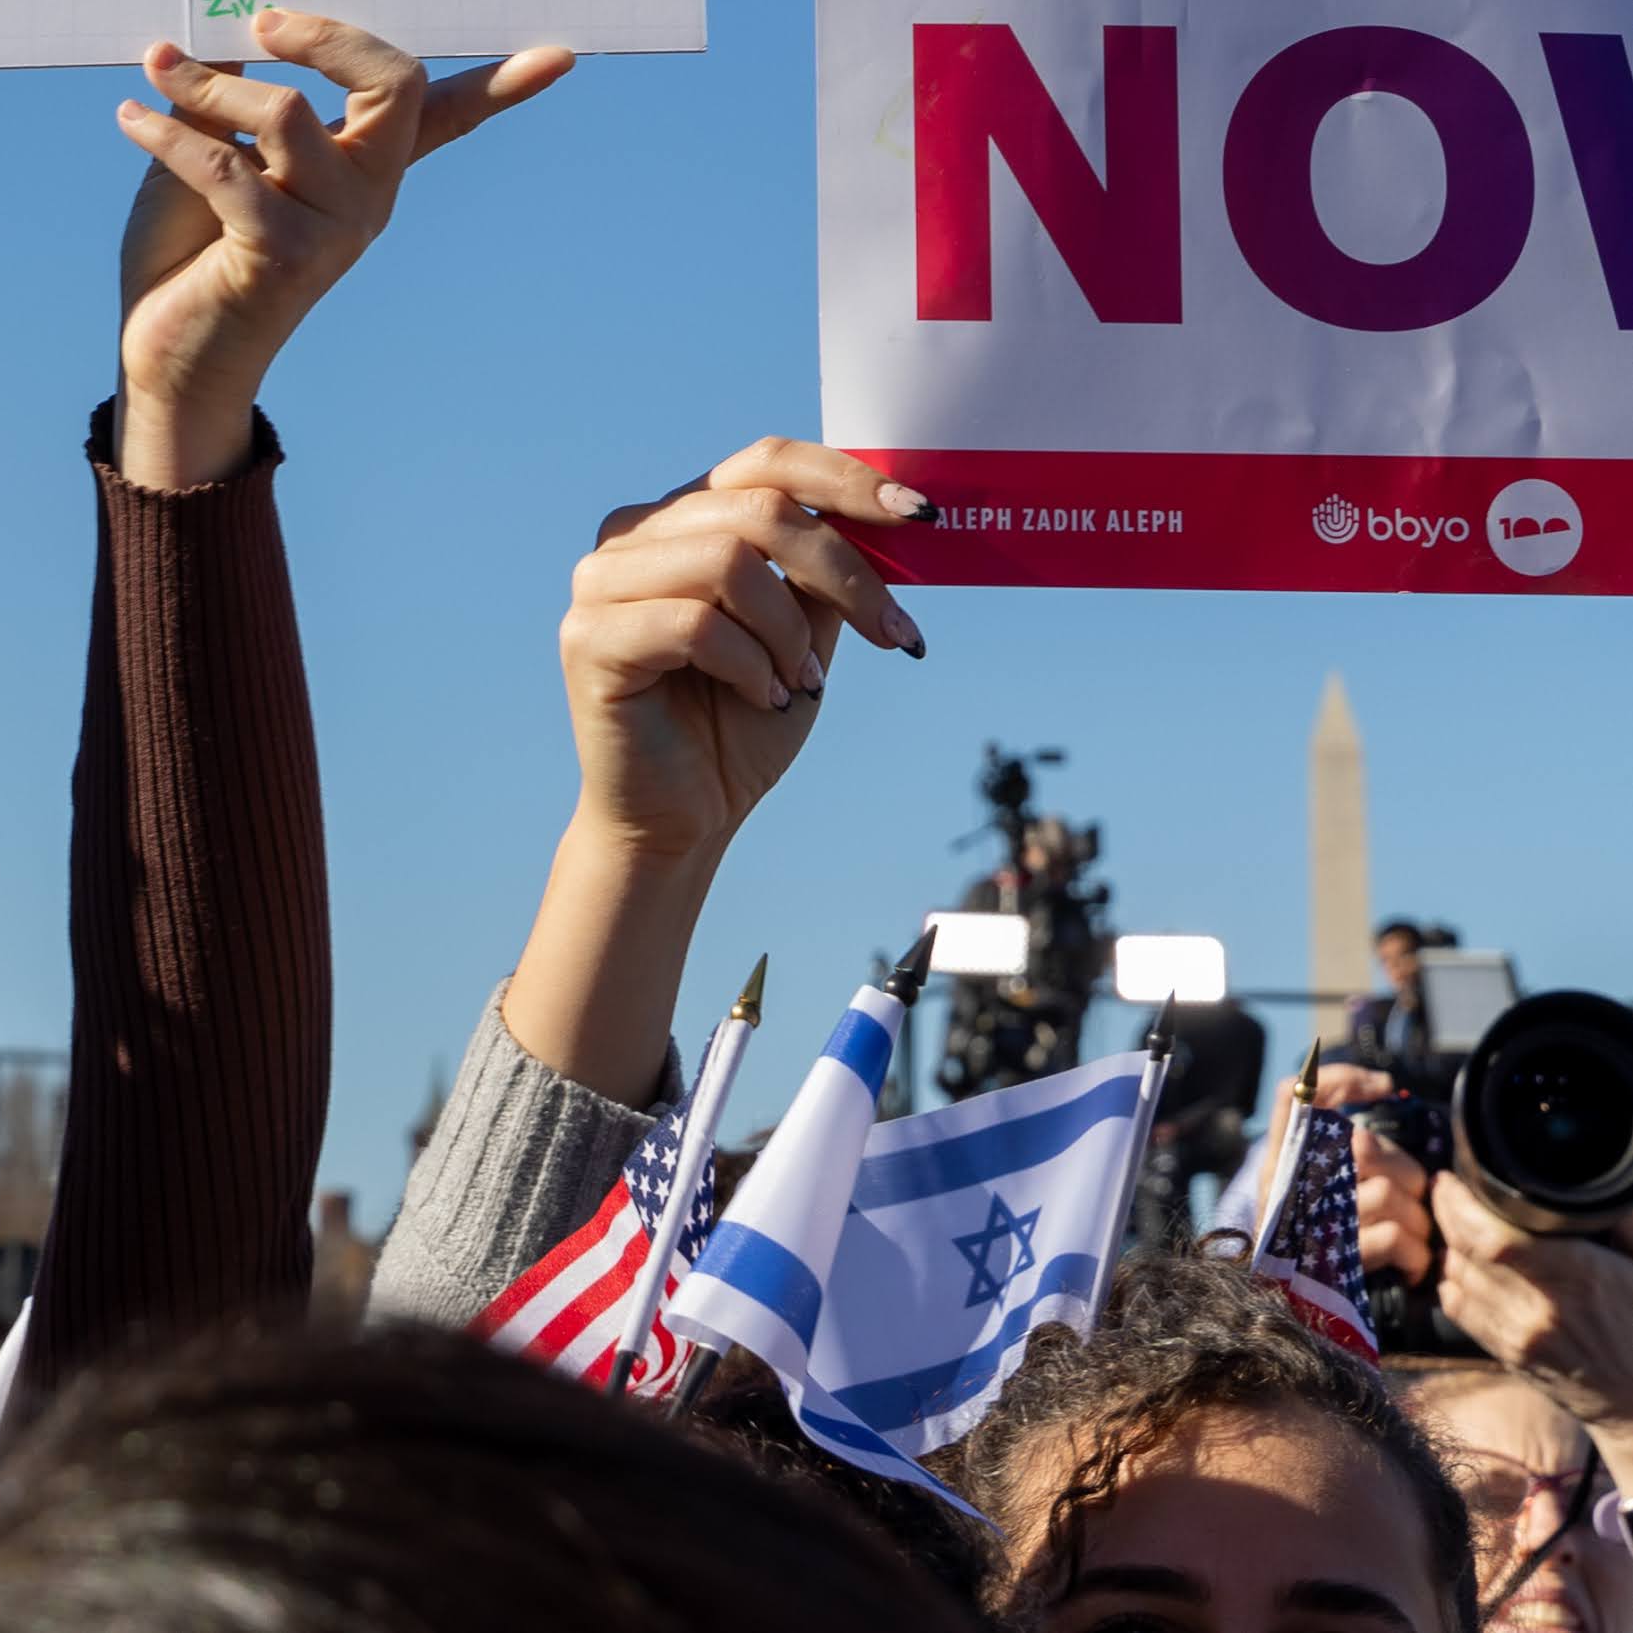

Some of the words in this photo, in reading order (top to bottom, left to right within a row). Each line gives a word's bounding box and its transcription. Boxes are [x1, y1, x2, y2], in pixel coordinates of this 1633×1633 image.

[912, 22, 1633, 333] NO
[934, 507, 1012, 531] ALEPH
[1021, 508, 1097, 532] ZADIK
[1105, 510, 1184, 533] ALEPH
[1367, 507, 1471, 549] bbyo
